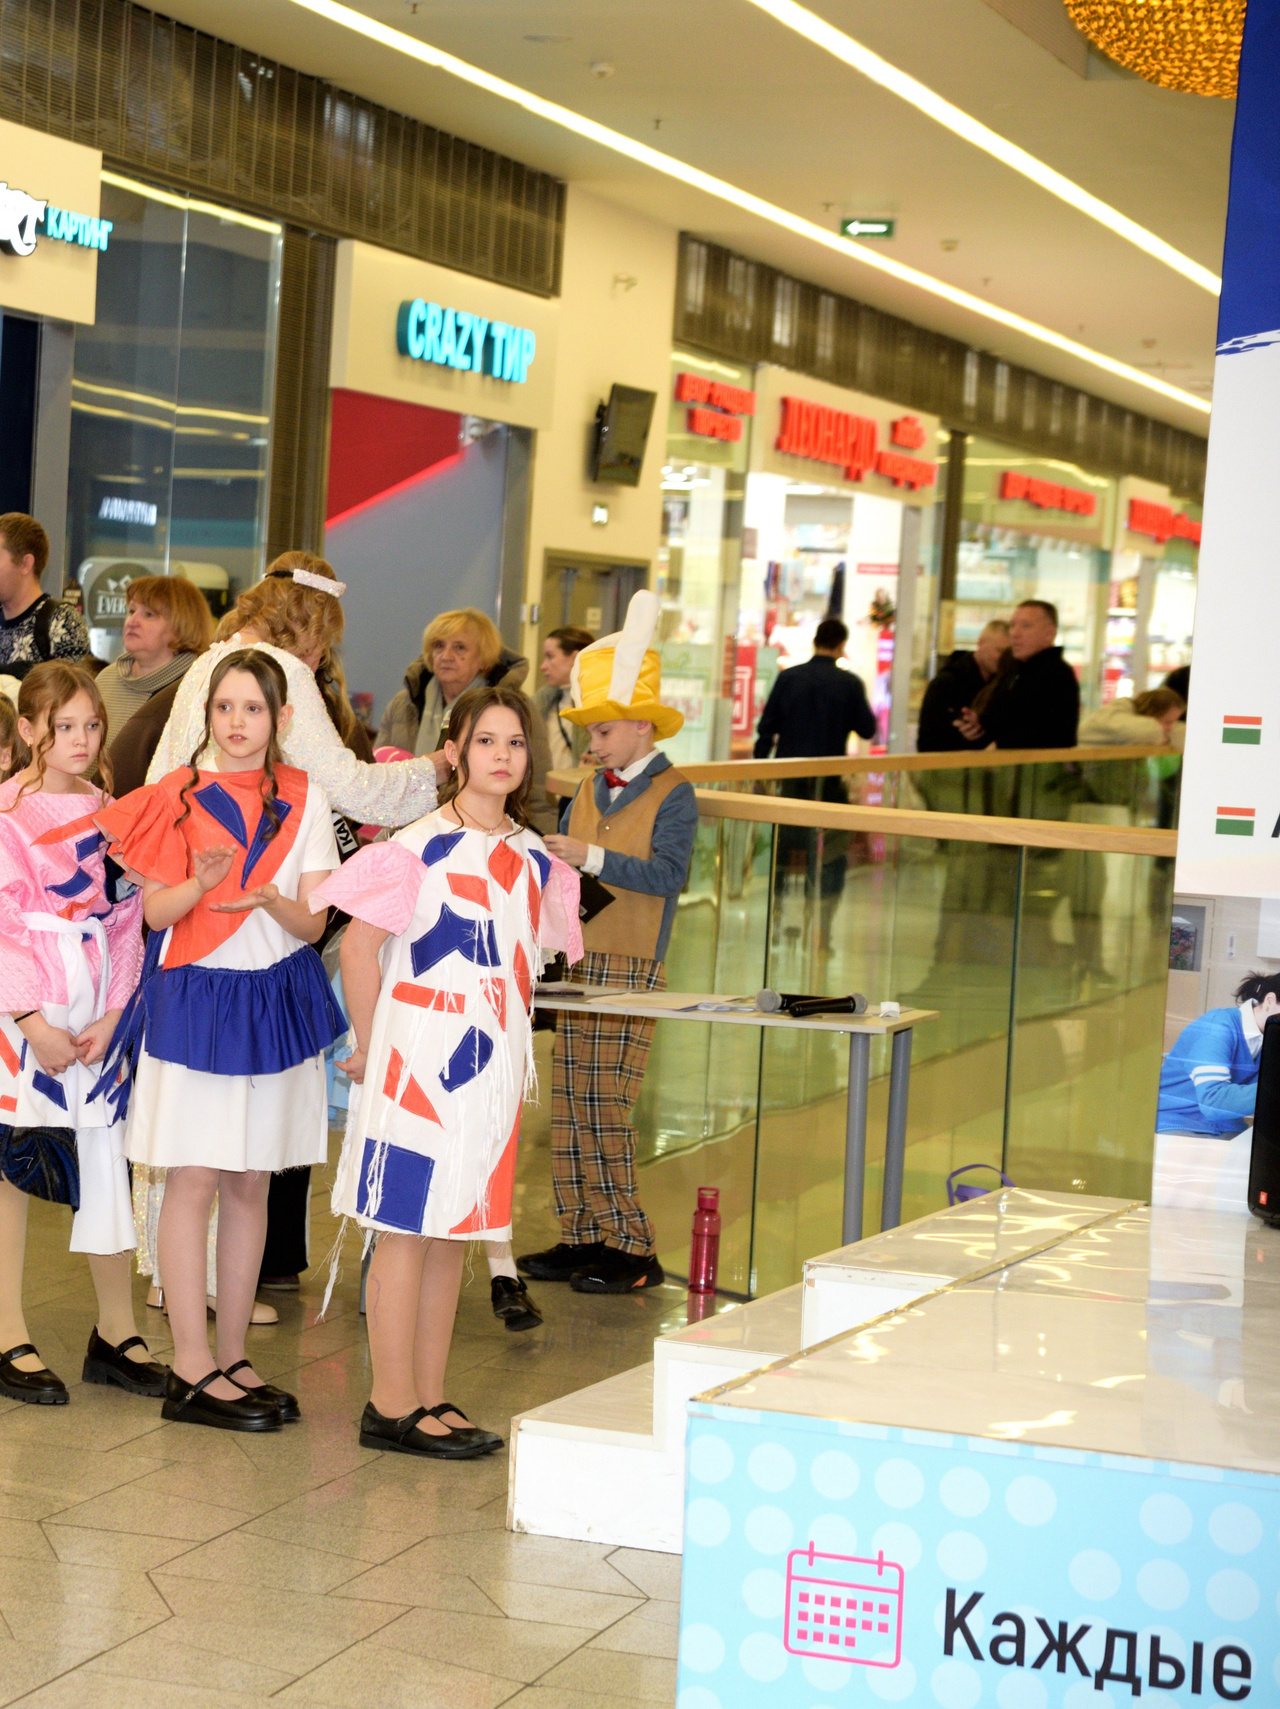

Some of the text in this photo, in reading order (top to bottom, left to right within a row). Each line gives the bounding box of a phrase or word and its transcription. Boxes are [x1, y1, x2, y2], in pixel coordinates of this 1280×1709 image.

[46, 206, 113, 252] КАРТИНГ
[404, 297, 536, 384] CRAZY ТИР
[97, 594, 127, 614] EVER
[941, 1587, 1254, 1702] Каждые
